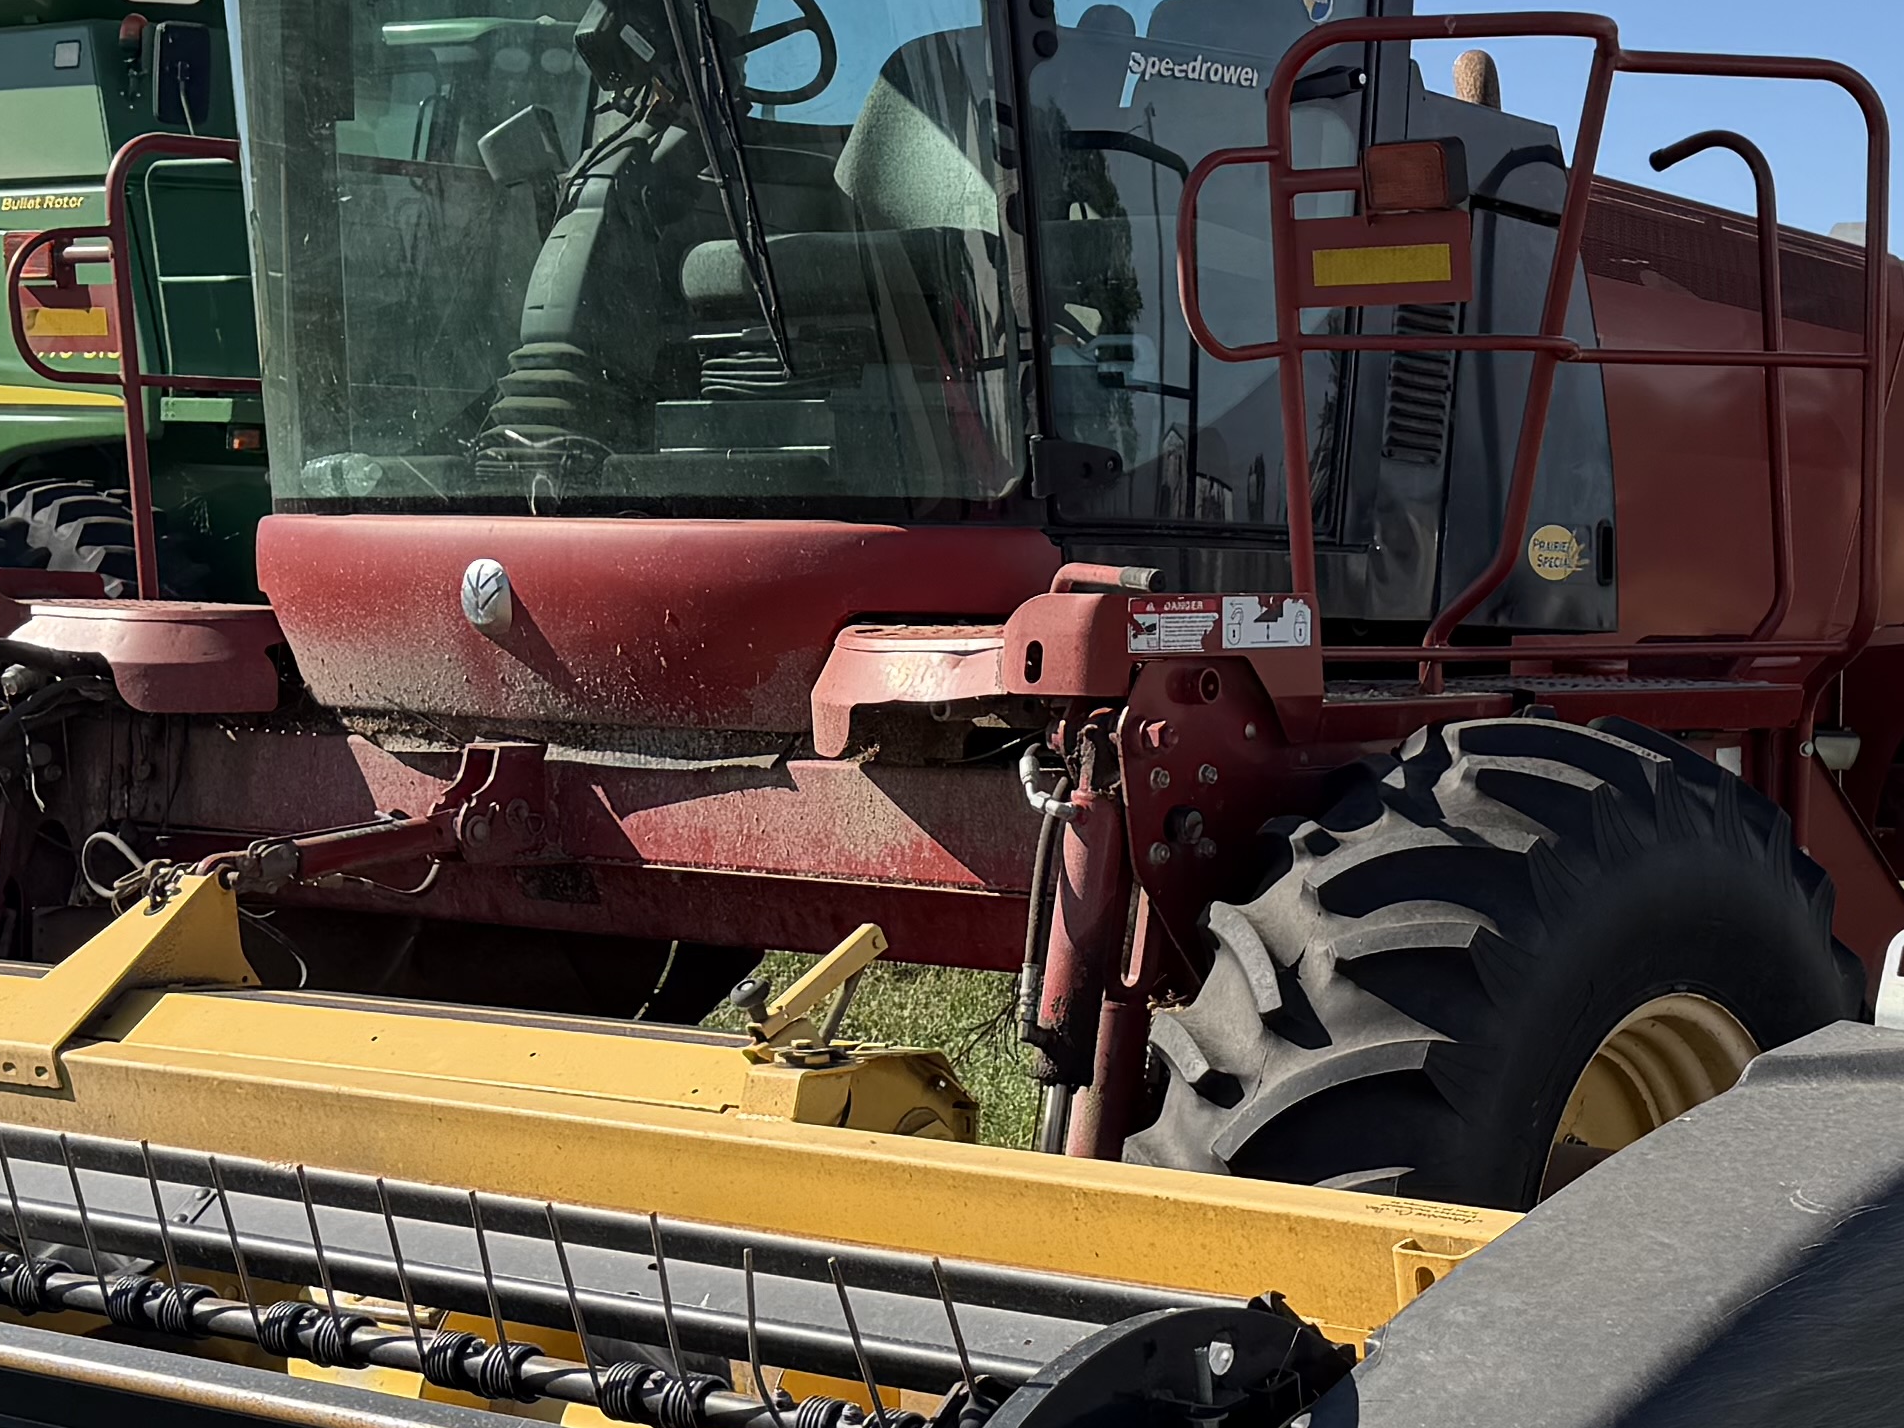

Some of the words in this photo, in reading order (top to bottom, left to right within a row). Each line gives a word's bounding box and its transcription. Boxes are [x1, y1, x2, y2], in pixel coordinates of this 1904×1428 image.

[1128, 51, 1259, 88] Speedrower
[1, 195, 42, 211] Bullet
[43, 195, 85, 209] Rotor
